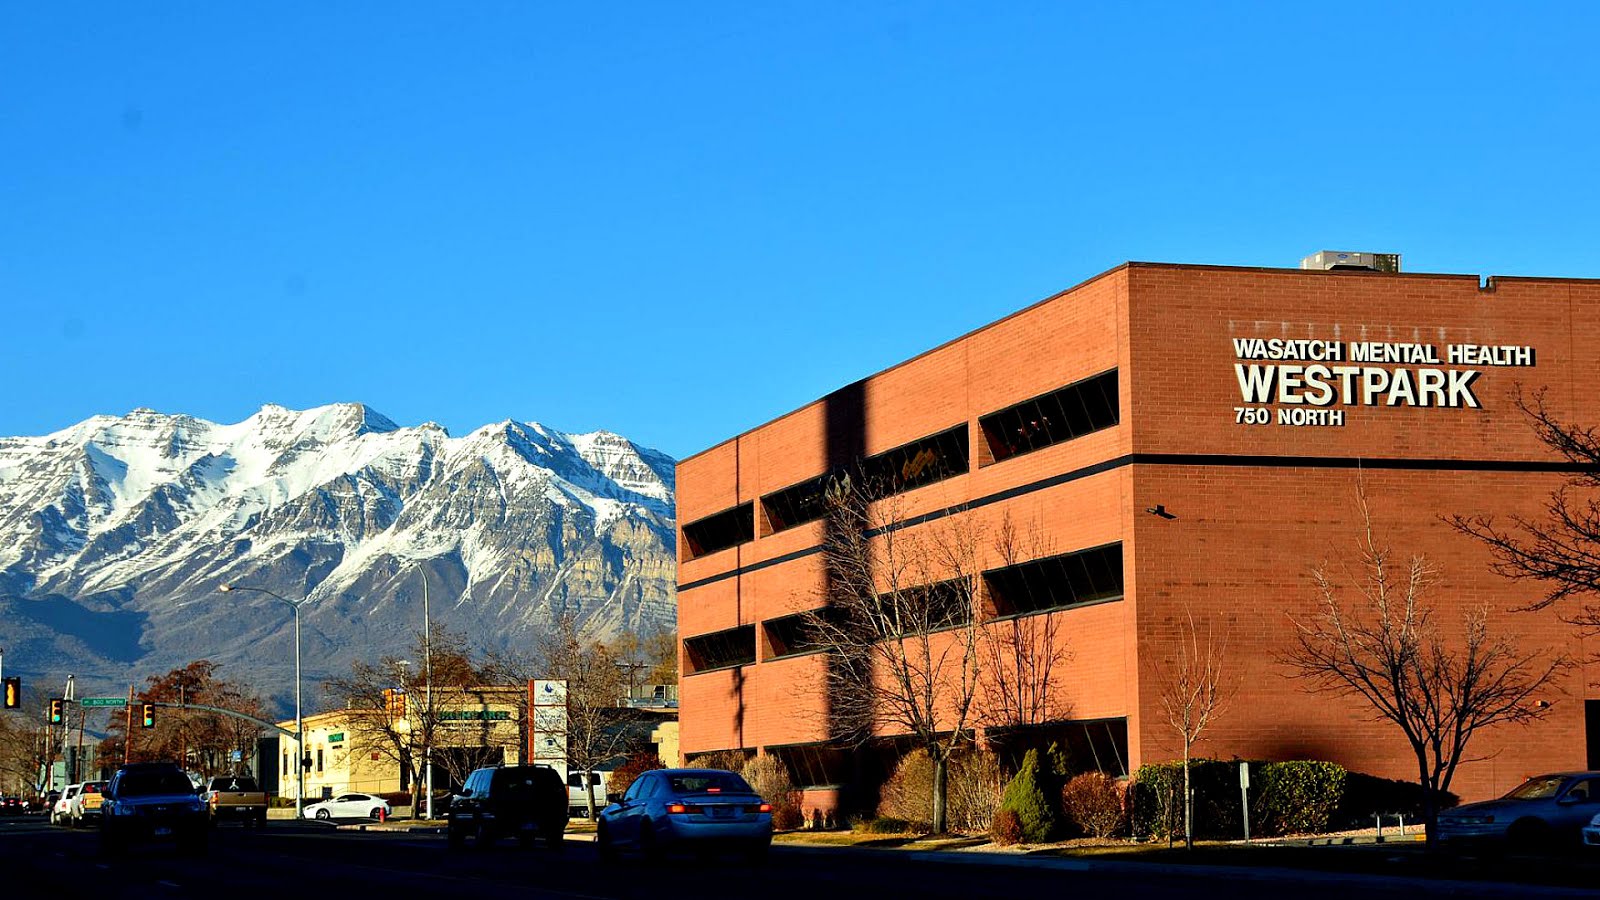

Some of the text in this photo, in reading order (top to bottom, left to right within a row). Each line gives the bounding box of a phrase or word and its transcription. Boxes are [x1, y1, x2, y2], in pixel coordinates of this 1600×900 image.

[1232, 337, 1531, 366] WASATCH MENTAL HEALTH
[1233, 363, 1478, 408] WESTPARK
[1233, 406, 1343, 426] 750 NORTH
